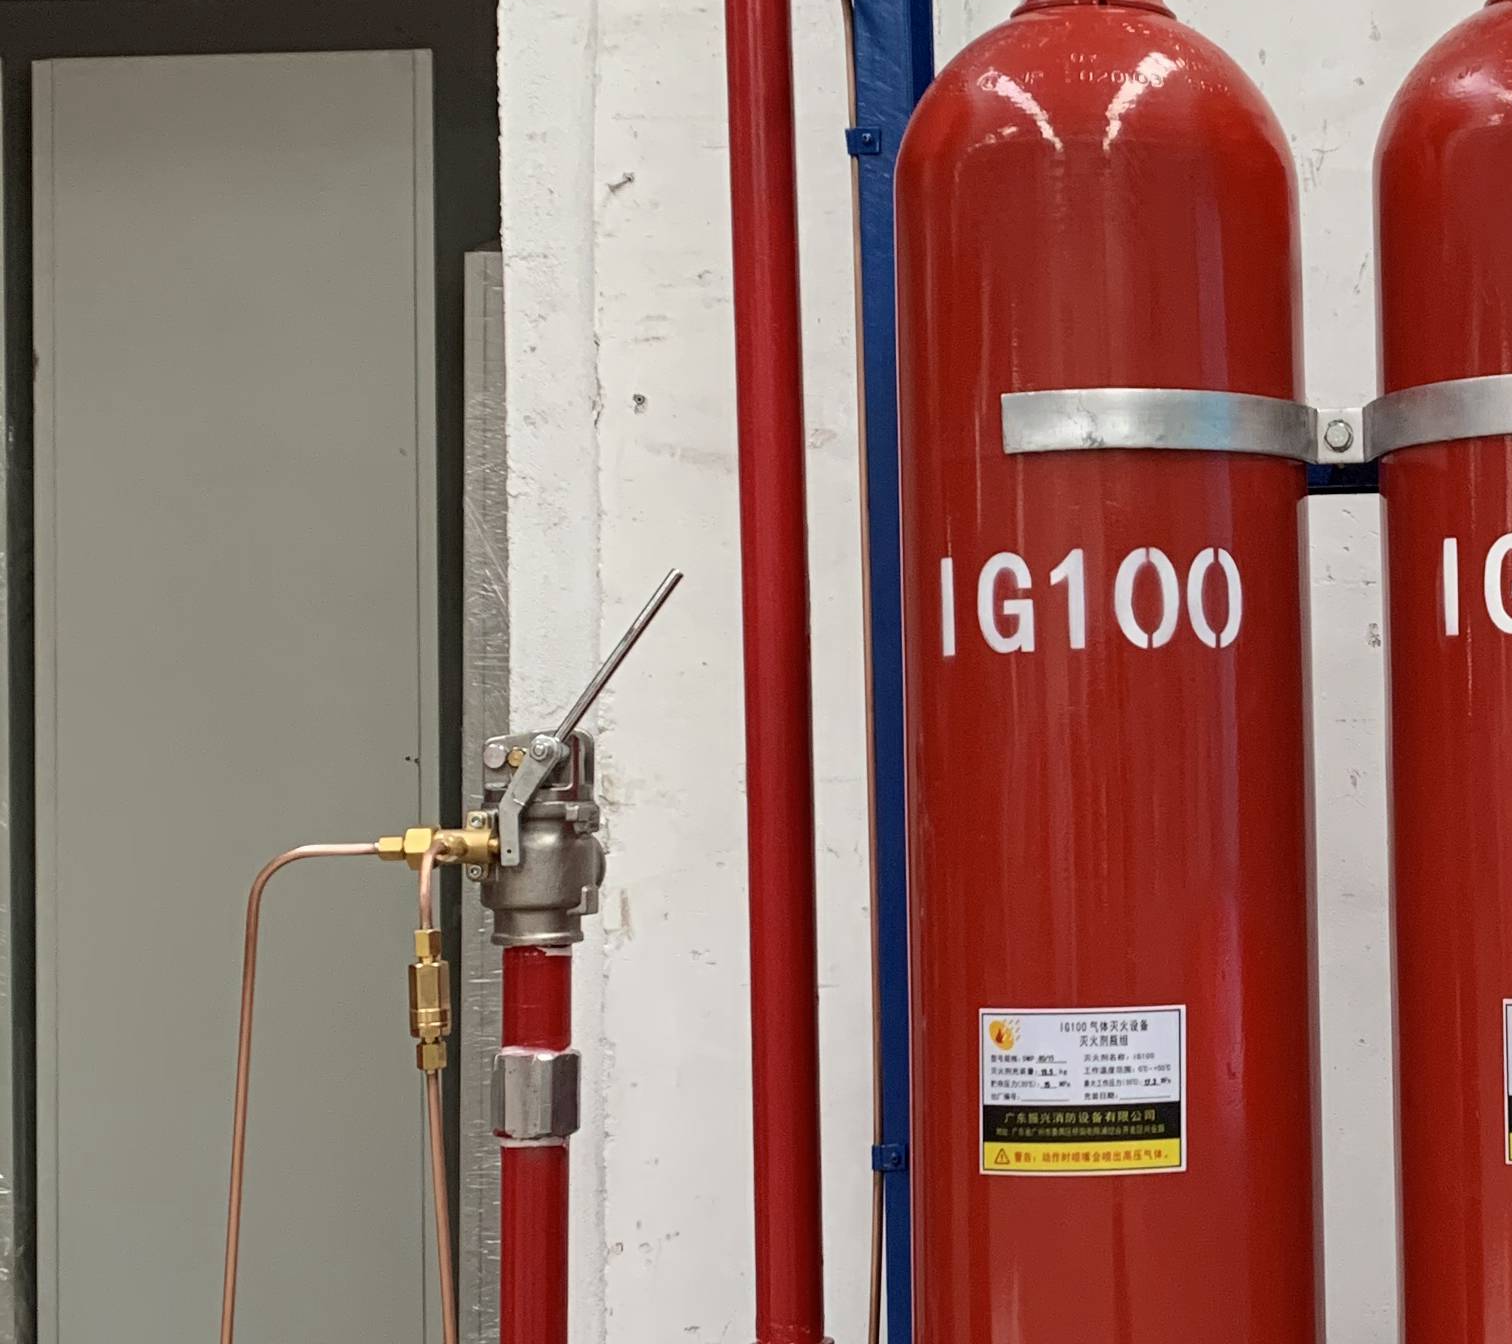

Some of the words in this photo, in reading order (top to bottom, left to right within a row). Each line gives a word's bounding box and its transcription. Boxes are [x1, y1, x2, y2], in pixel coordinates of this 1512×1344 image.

[941, 546, 1243, 656] IG100
[1060, 1022, 1087, 1032] IG100
[1090, 1020, 1148, 1031] 气体灭火设备
